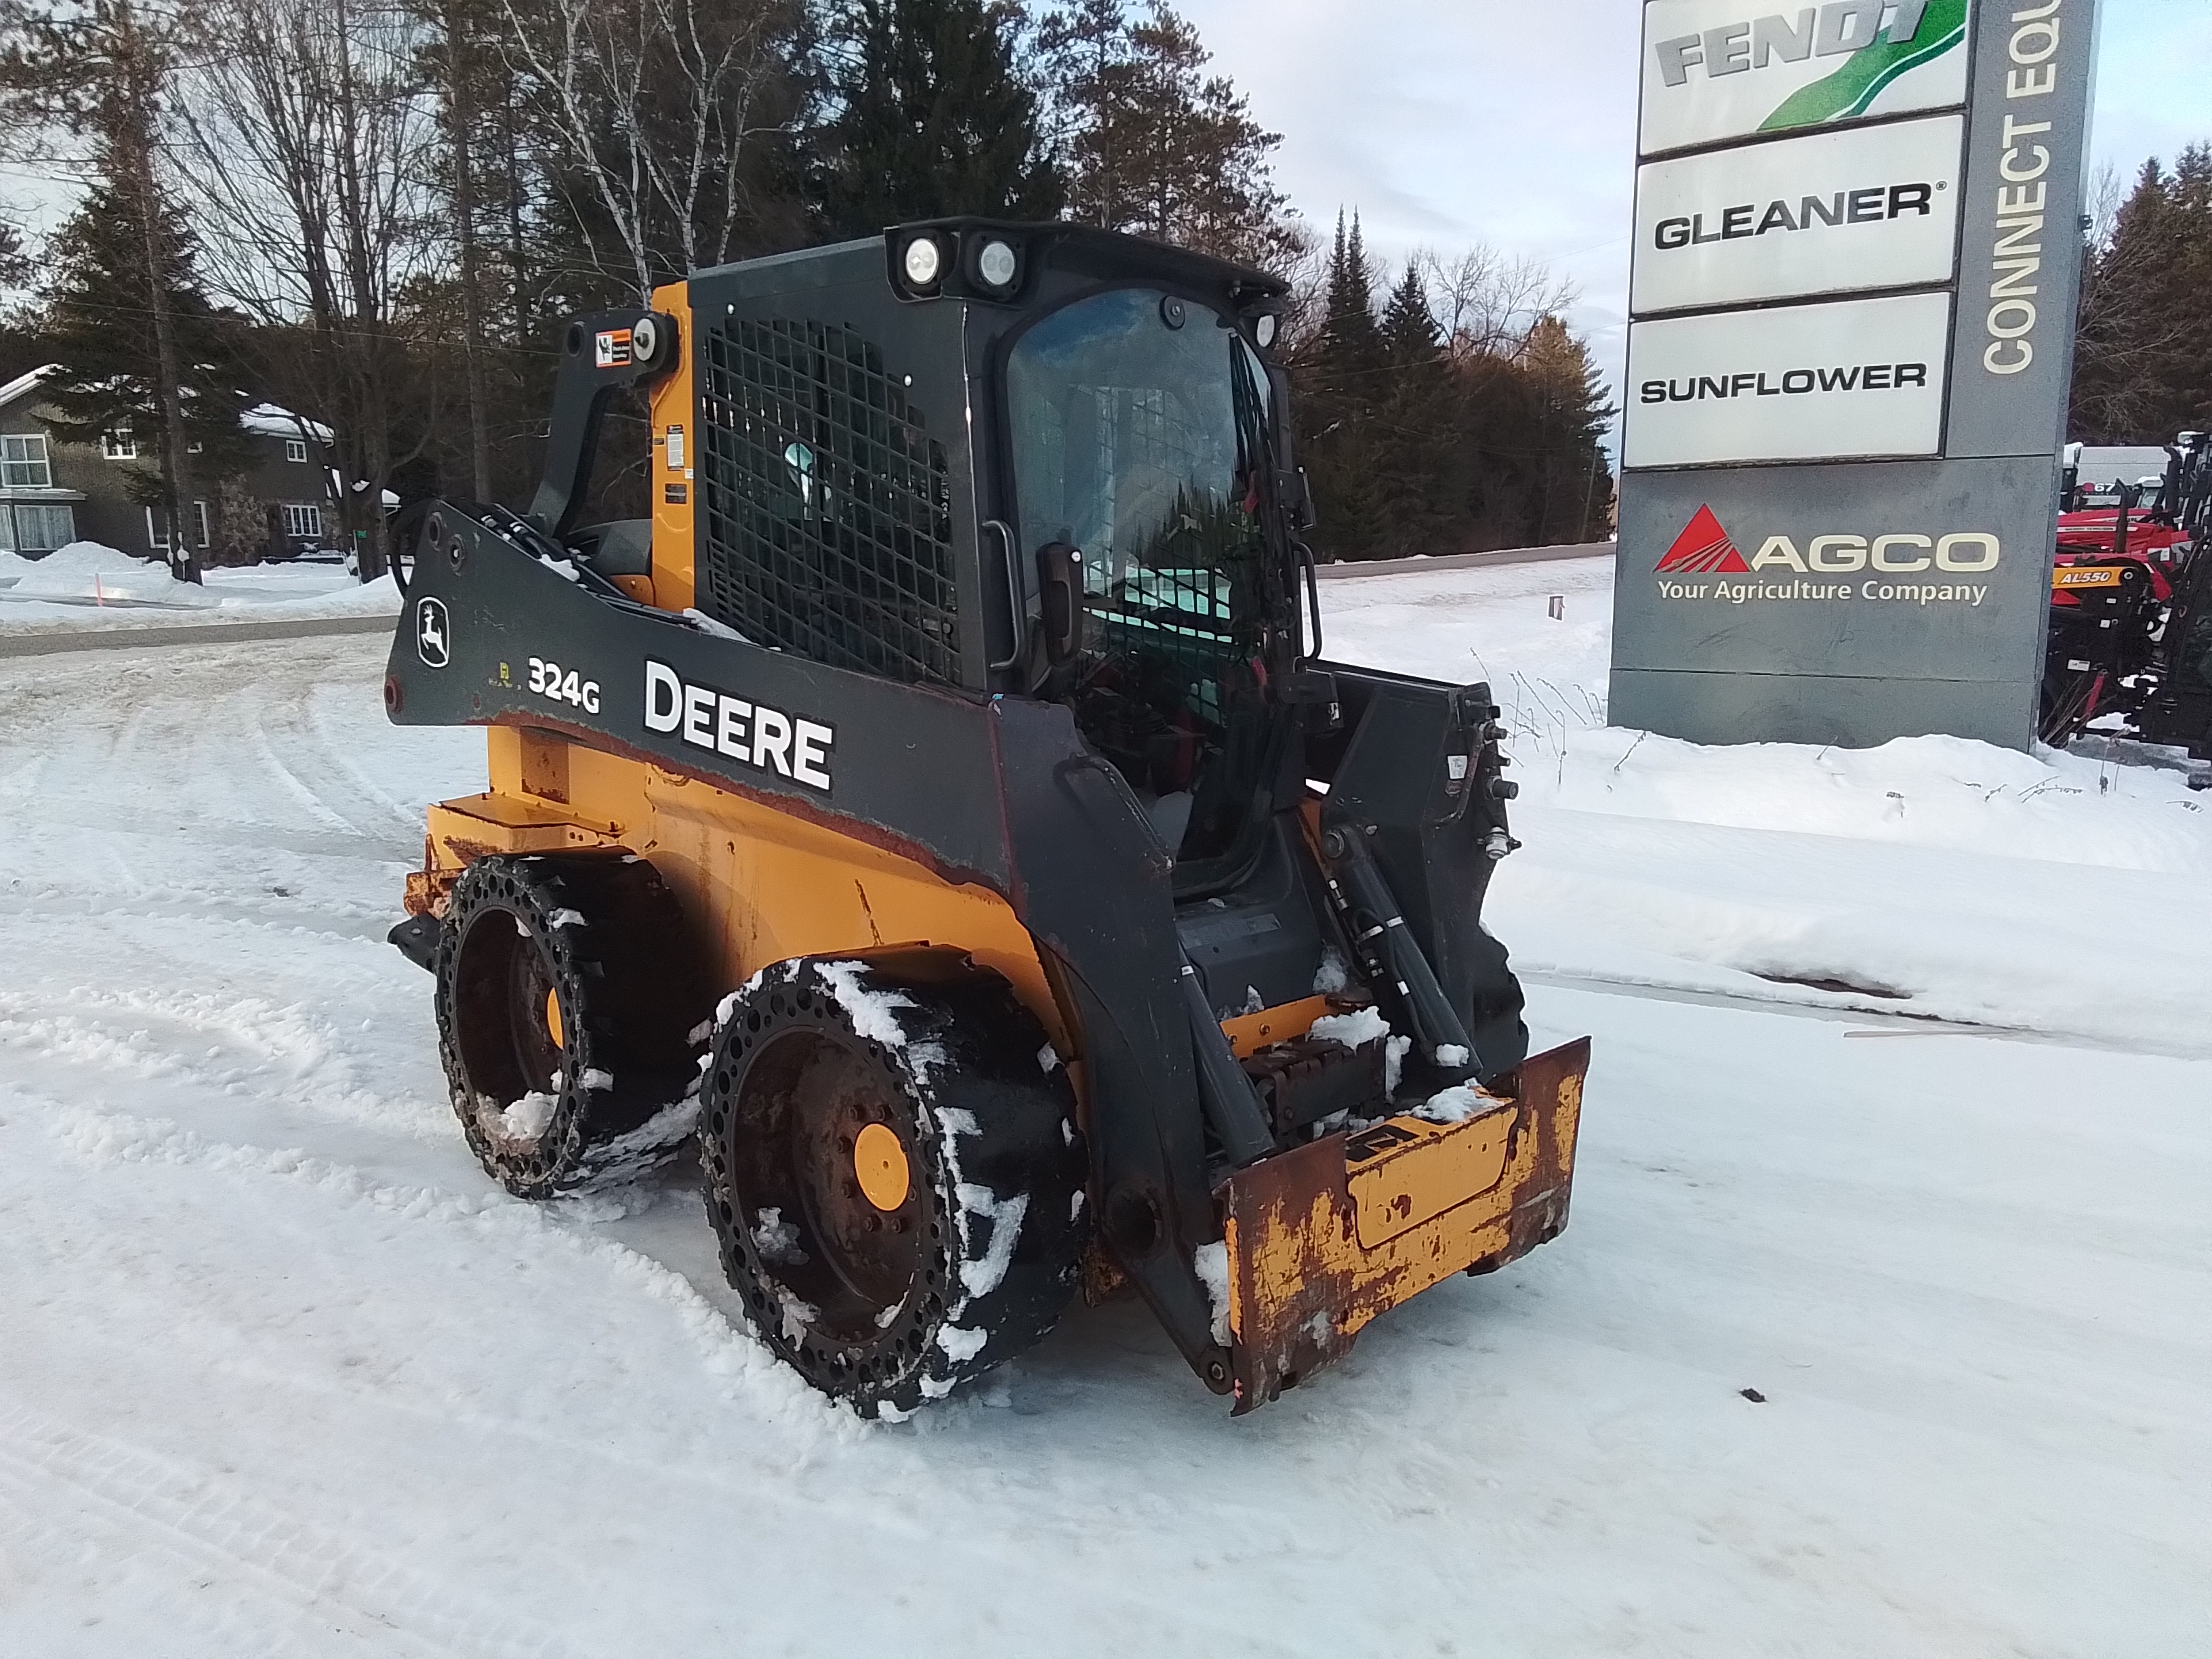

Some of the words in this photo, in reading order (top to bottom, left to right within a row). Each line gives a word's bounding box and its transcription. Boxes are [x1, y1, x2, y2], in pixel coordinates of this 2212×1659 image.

[1655, 0, 1929, 87] FENDT
[1983, 114, 2049, 375] CONNECT
[1641, 363, 1926, 403] SUNFLOWER
[1751, 533, 1999, 572] AGCO
[1658, 580, 1708, 600] Your
[1714, 579, 1851, 604] Agriculture
[1862, 581, 1988, 606] Company
[2060, 571, 2110, 583] AL550
[528, 657, 600, 714] 324G
[644, 661, 833, 790] DEERE
